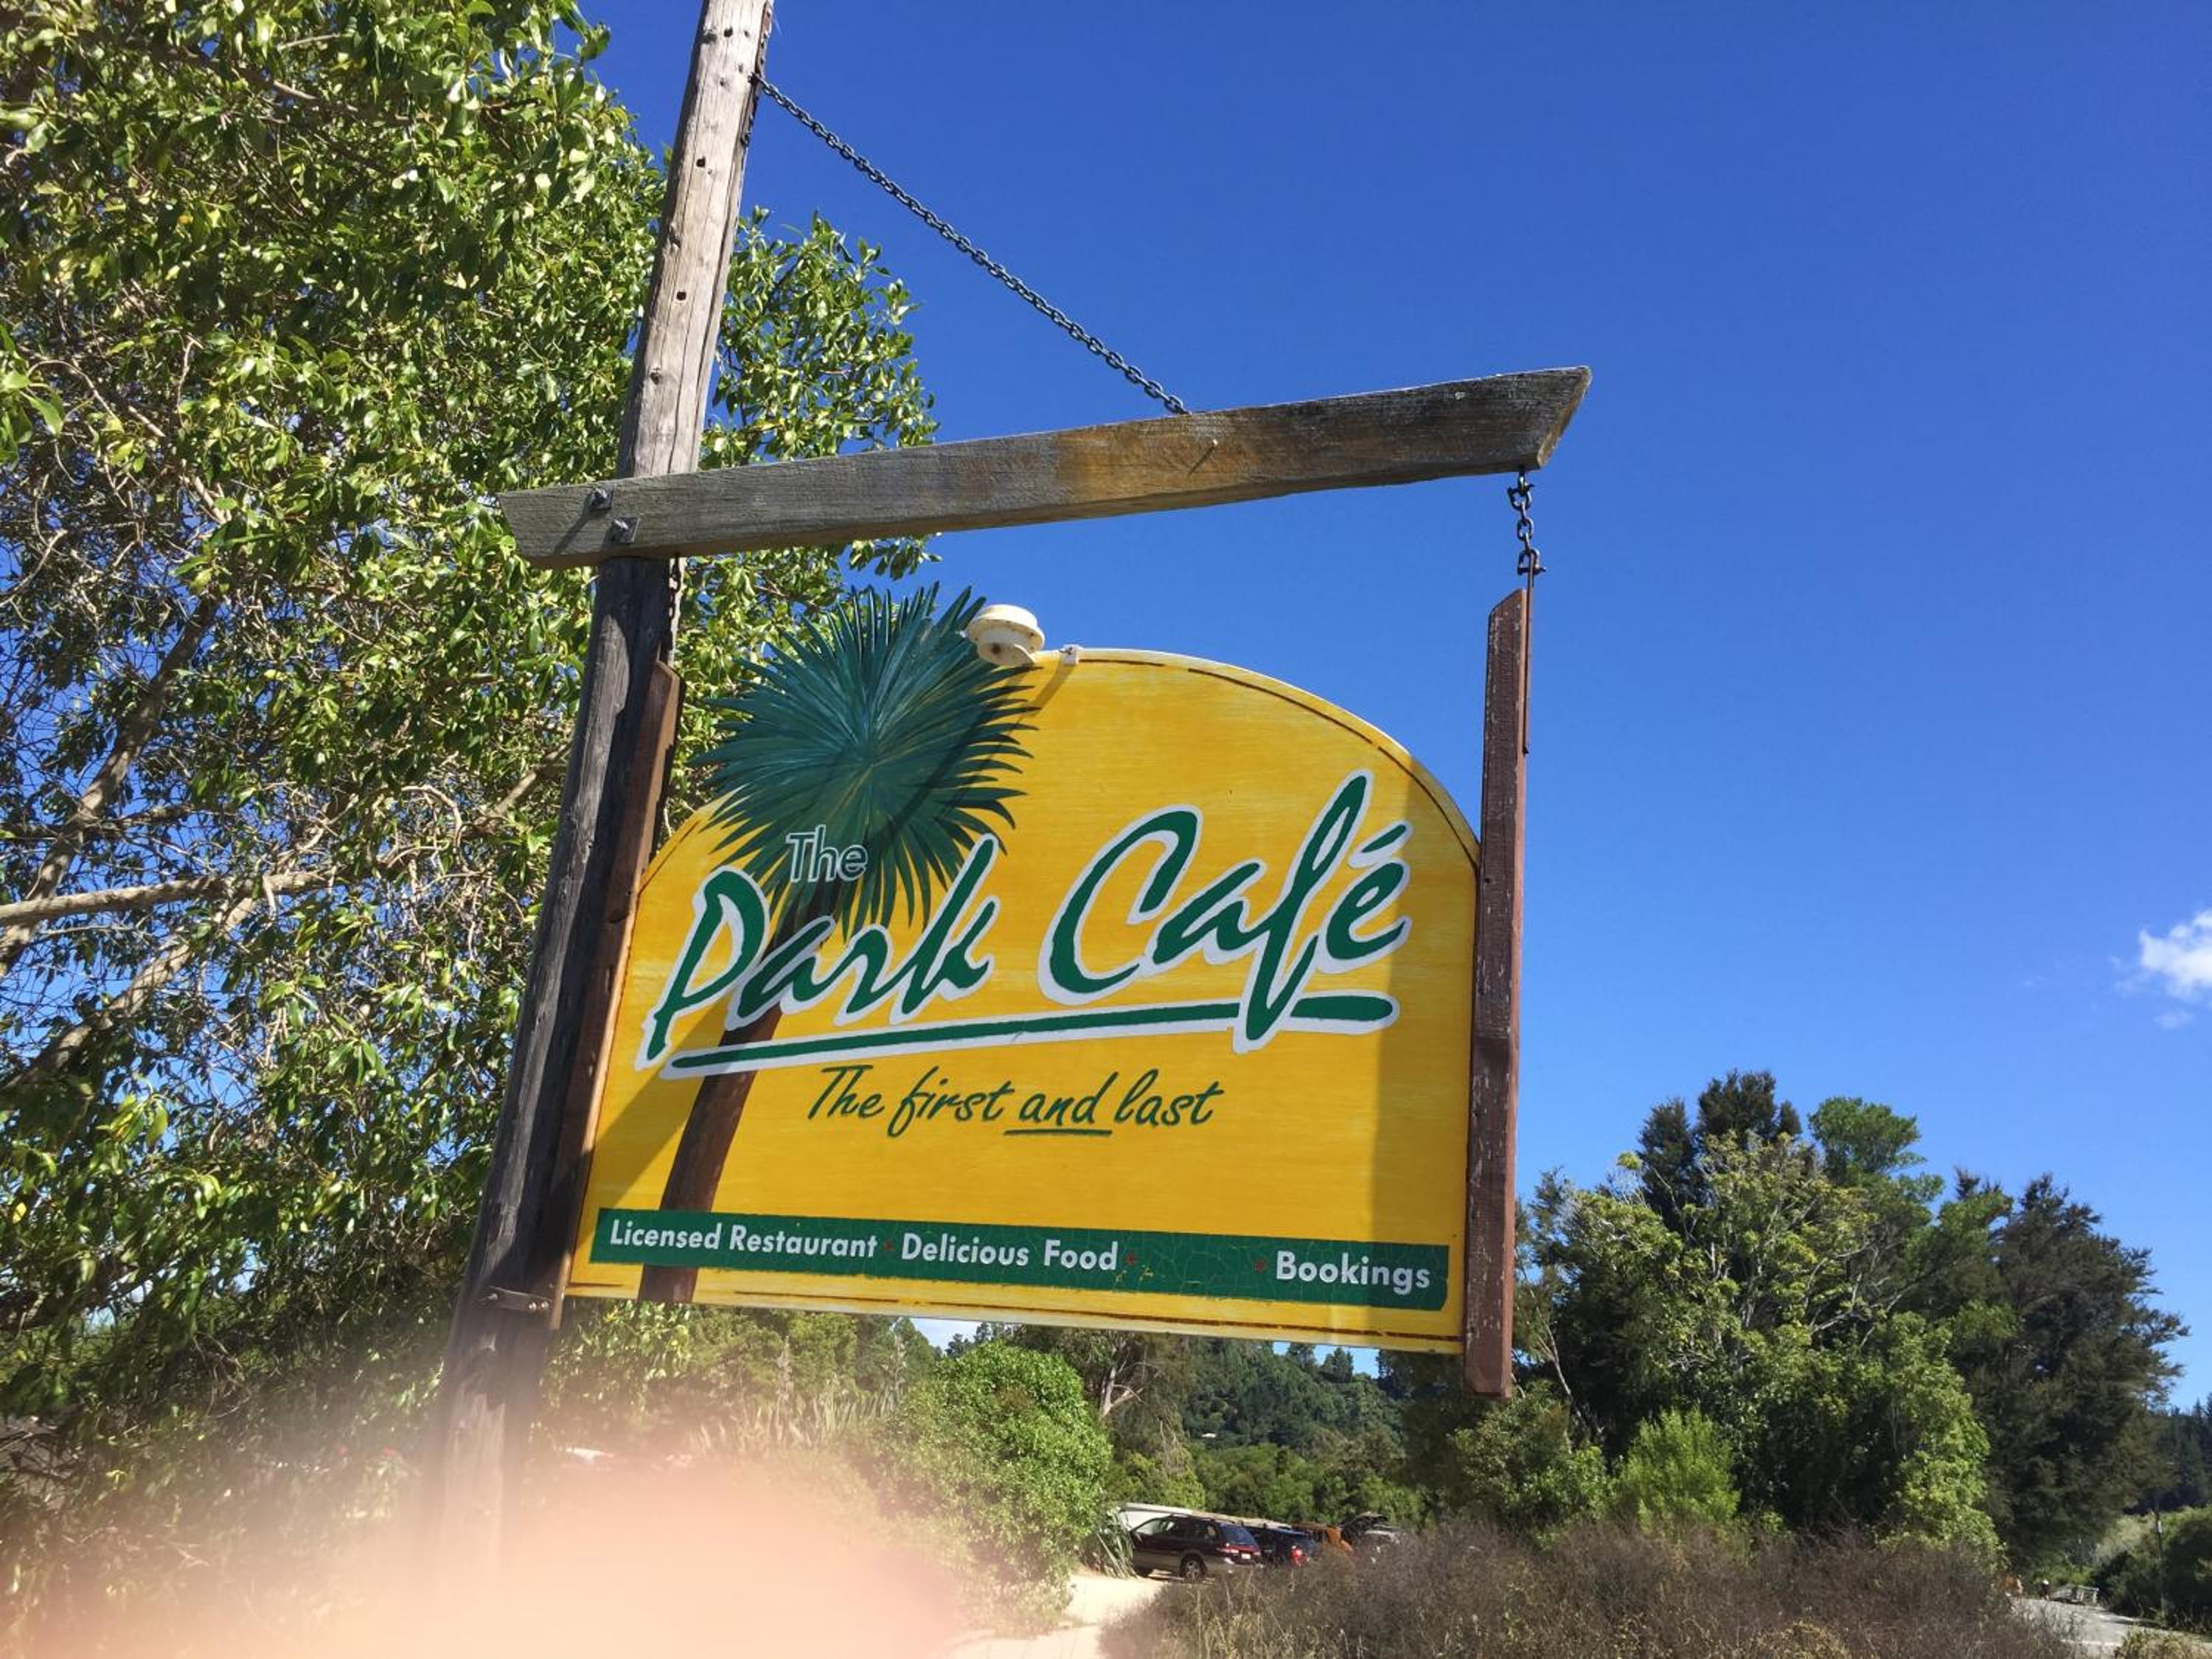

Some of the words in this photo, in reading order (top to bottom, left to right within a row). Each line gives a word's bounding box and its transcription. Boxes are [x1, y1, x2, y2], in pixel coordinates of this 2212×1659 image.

[786, 825, 868, 882] The
[635, 834, 1000, 1071] Park
[1038, 769, 1411, 1054] Café
[808, 1064, 884, 1119] The
[886, 1065, 1015, 1138] first
[1018, 1071, 1119, 1126] and
[1113, 1068, 1224, 1127] last
[610, 1219, 723, 1250] Licensed
[729, 1225, 878, 1257] Restaurant
[900, 1232, 1029, 1267] Delicious
[1043, 1239, 1119, 1271] Food
[1276, 1250, 1430, 1295] Bookings
